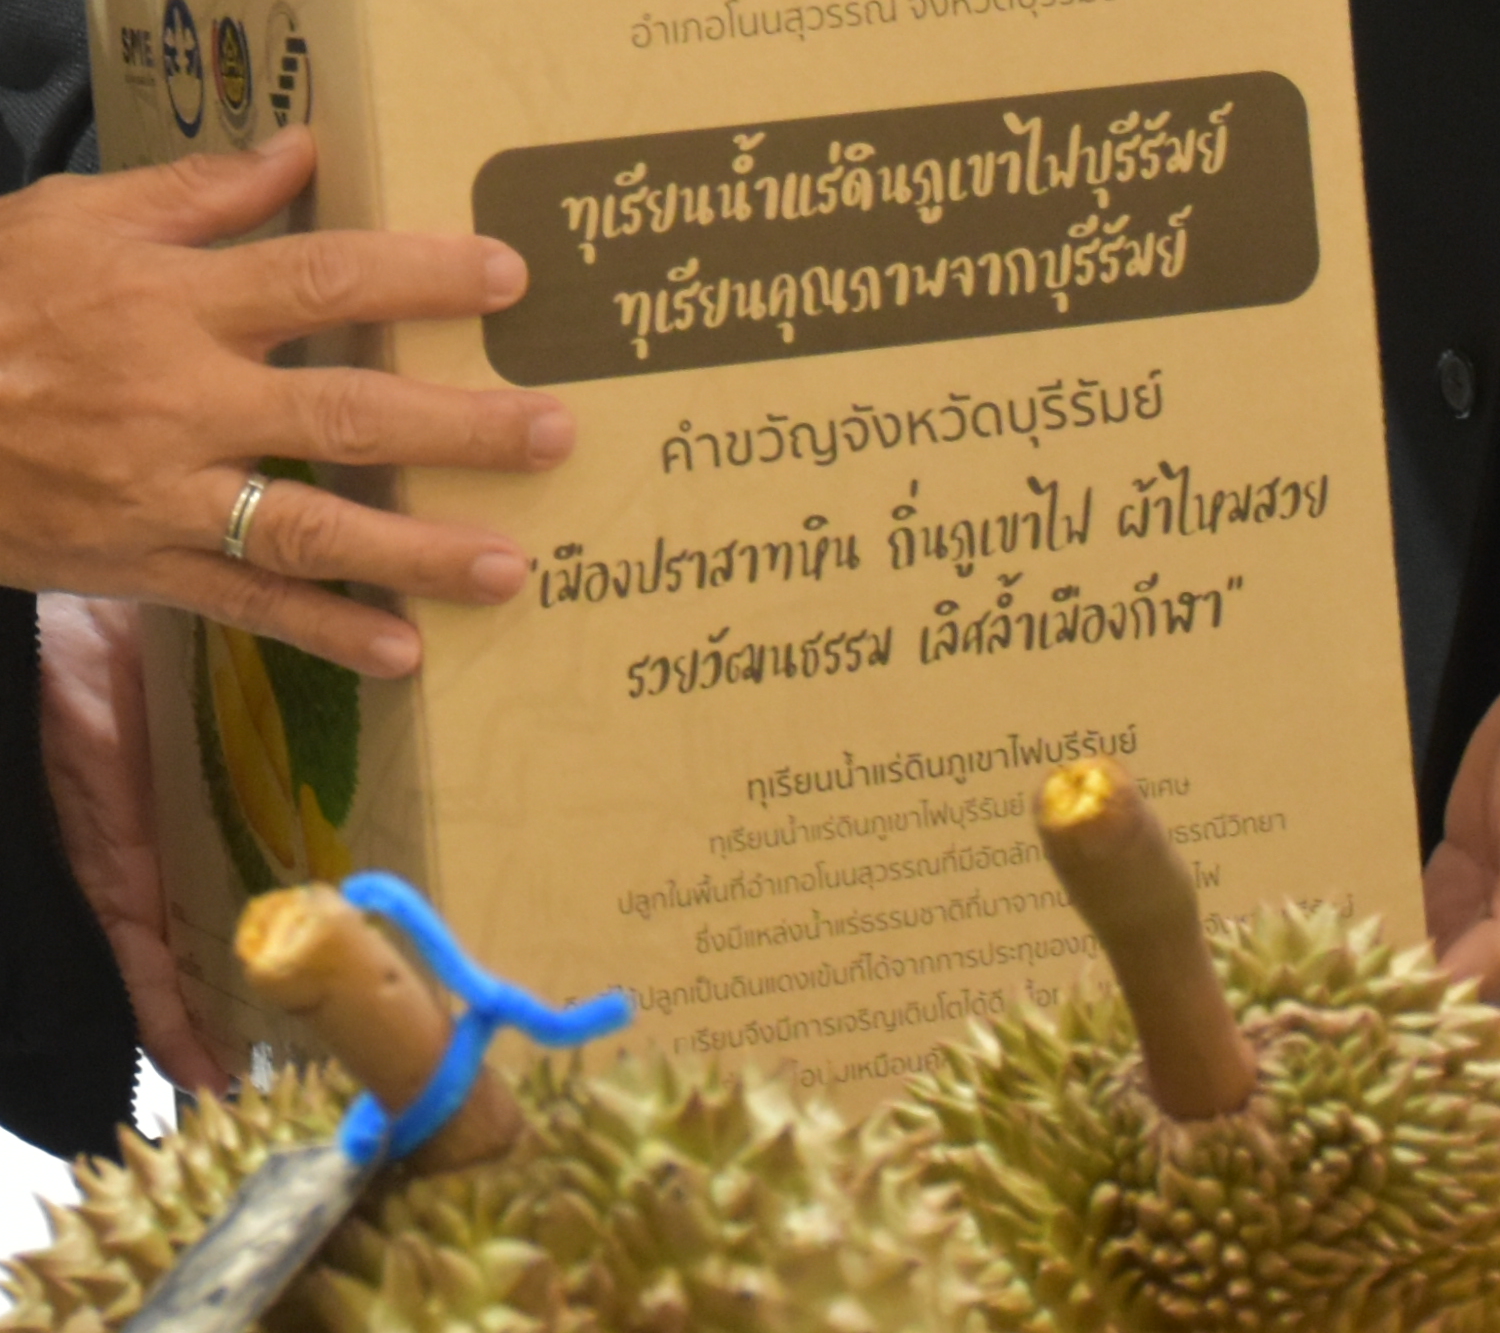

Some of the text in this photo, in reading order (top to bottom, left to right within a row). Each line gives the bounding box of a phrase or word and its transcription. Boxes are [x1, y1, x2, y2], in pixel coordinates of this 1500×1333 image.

[562, 104, 1236, 263] ทุเรียนน้ำแร่ดินภูเขาไฟบุรีรัมย์
[615, 207, 1195, 360] ทุเรียนคุณภาพจากบุรีรัมย์
[662, 370, 1163, 474] คำขวัญจังหวัดบุรีรัมย์
[889, 474, 1093, 575] ถิ่นภูเขาไฟ
[1119, 462, 1331, 538] ผ้าไหมสวย
[627, 626, 894, 699] รวยวัฒนธรรม
[710, 792, 1024, 857] ทุเรียนน้ำแร่ดินภูเขาไฟบุรีรัมย์
